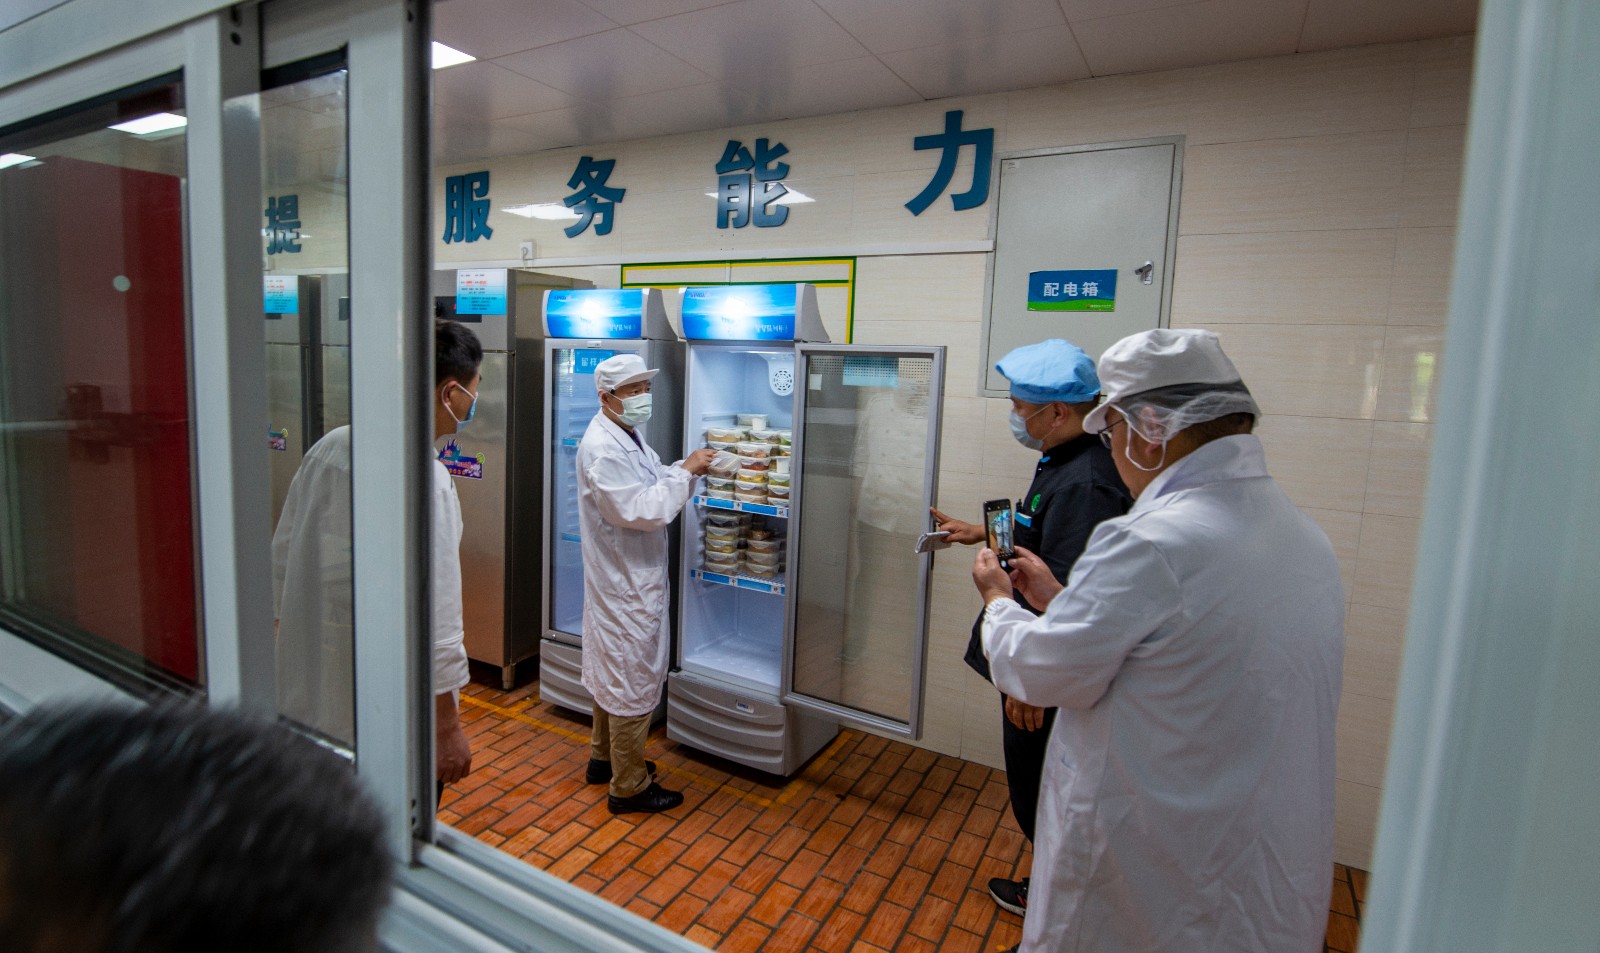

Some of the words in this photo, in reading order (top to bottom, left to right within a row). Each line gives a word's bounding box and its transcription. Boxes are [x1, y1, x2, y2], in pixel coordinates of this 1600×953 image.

[1043, 281, 1099, 297] 配电箱
[581, 357, 605, 367] 留样
